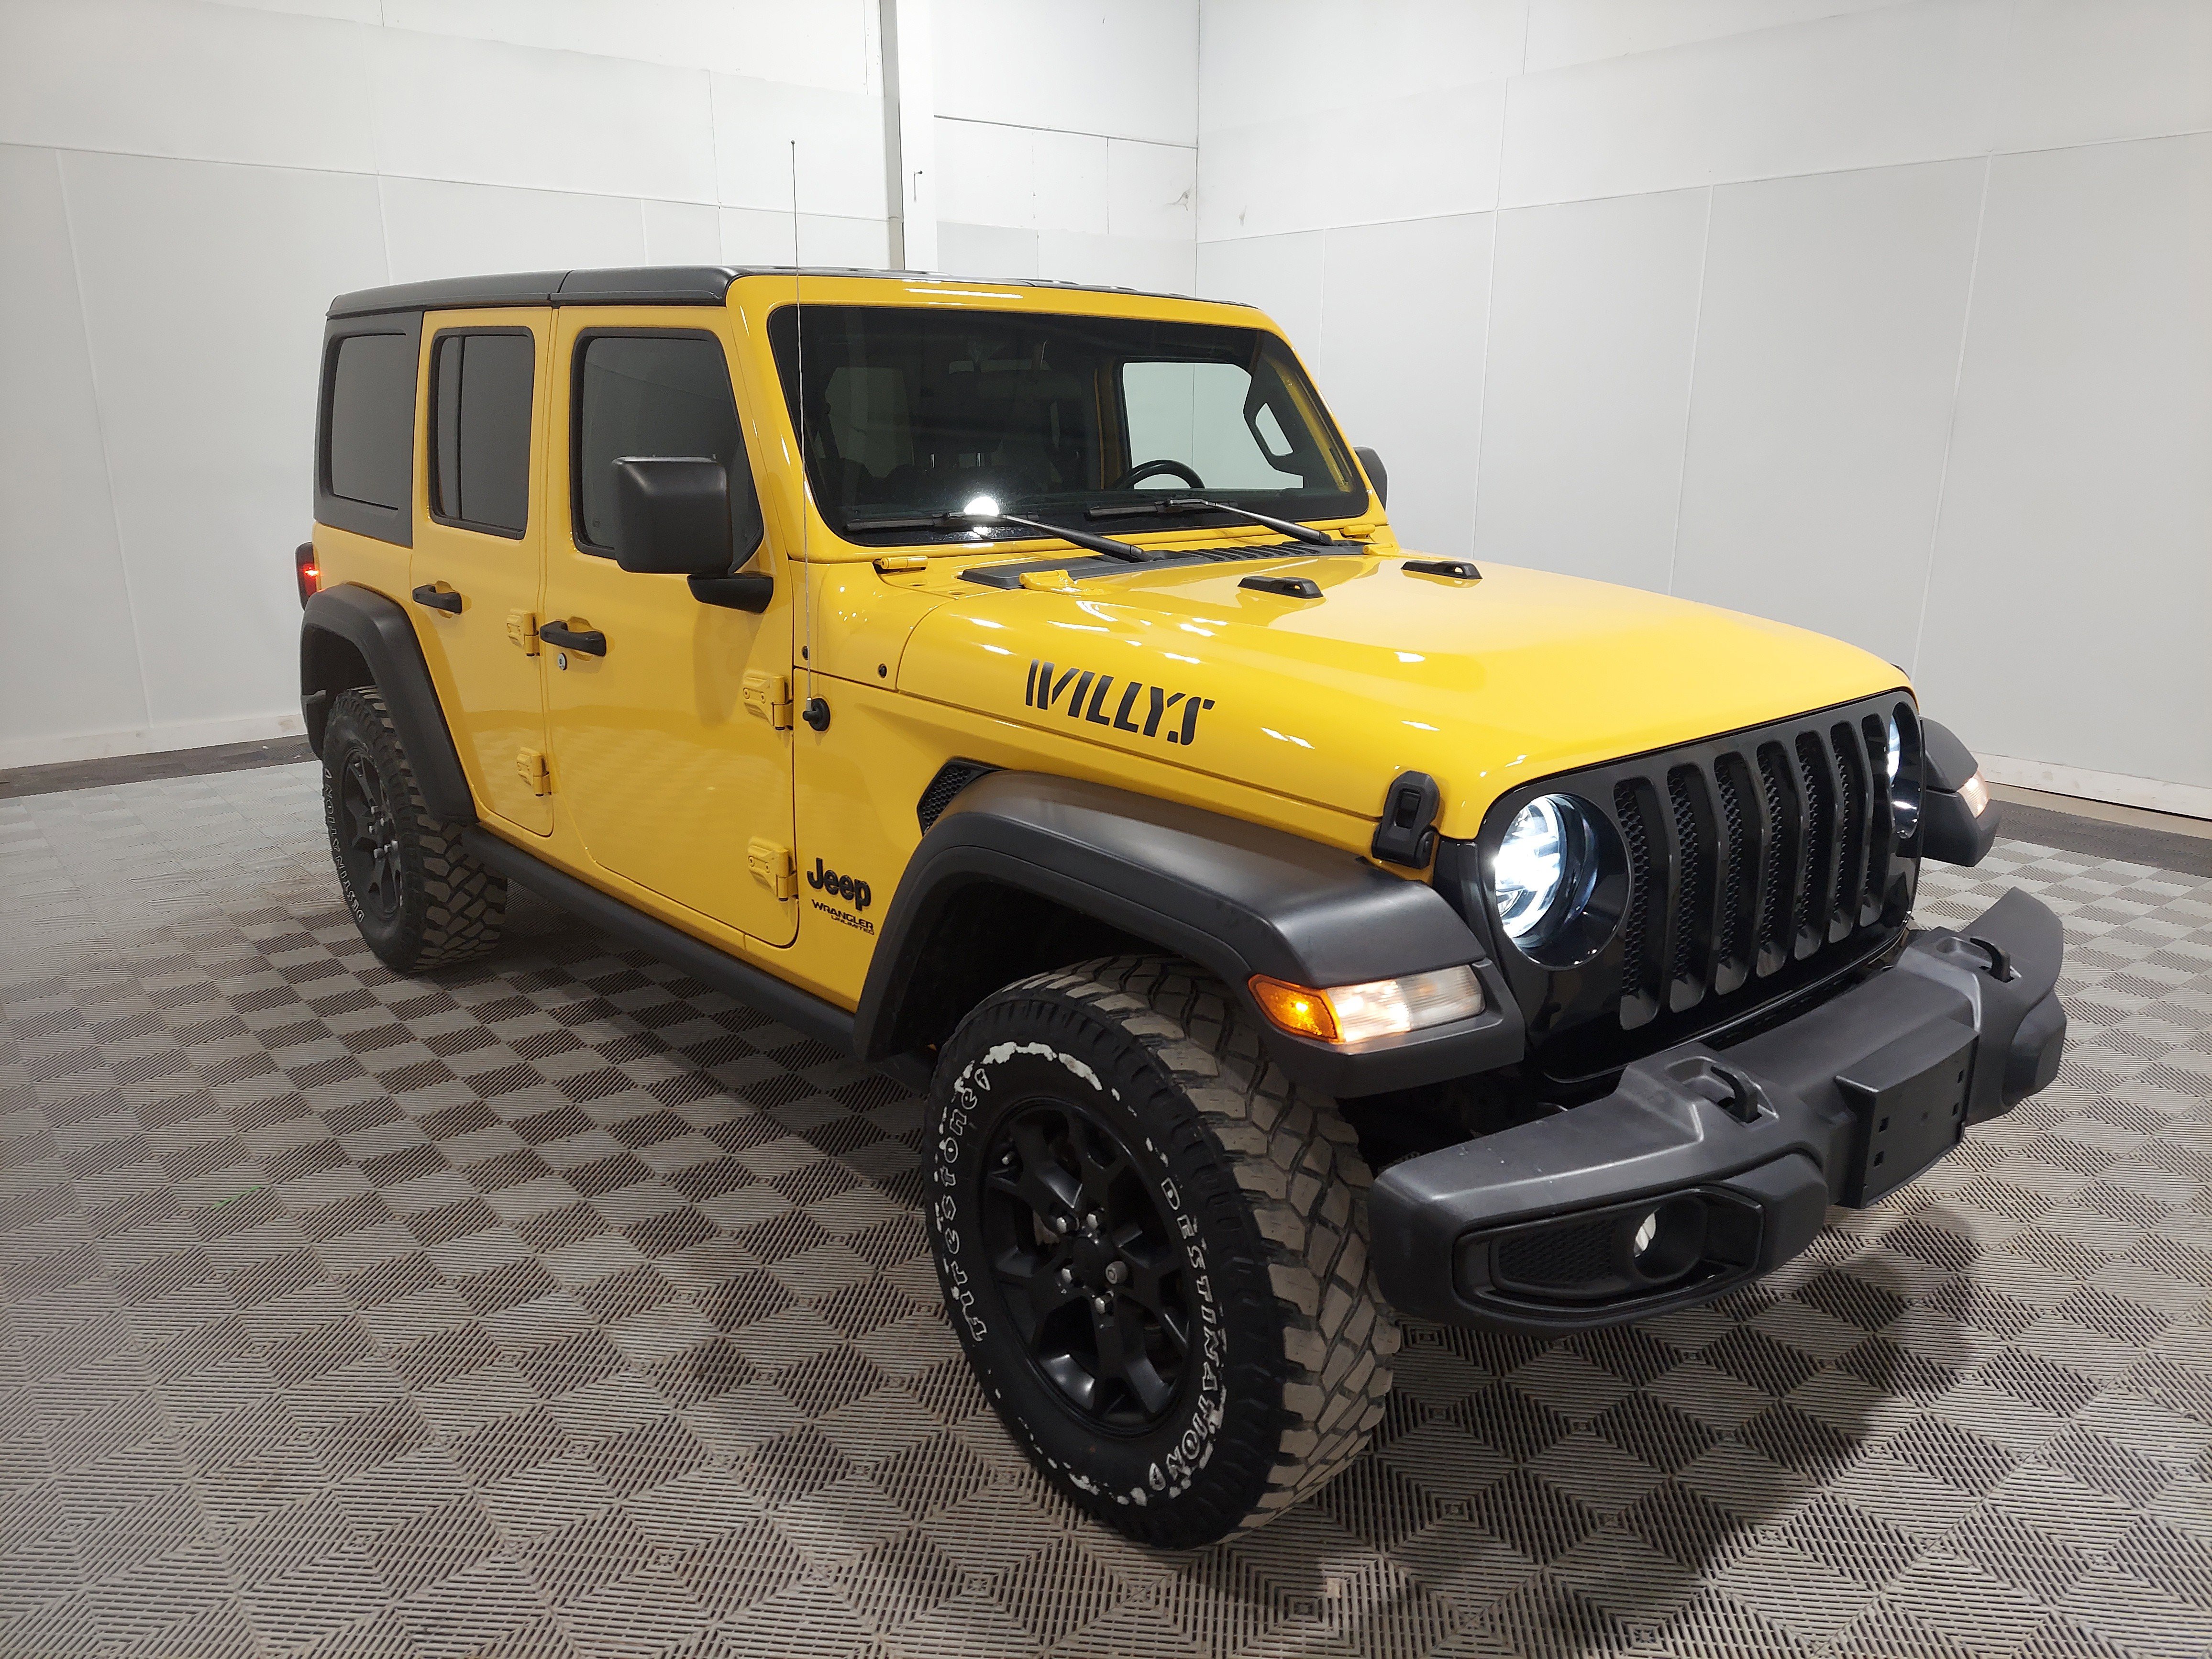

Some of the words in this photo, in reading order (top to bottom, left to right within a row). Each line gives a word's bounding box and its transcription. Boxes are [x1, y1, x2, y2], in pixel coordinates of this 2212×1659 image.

[1026, 659, 1215, 746] WILLYS
[323, 784, 365, 923] DESTINATION
[807, 857, 872, 911] Jeep
[811, 899, 874, 931] WRANGLER
[831, 915, 875, 935] UNLIMITED
[1161, 1176, 1227, 1485] DESTINATION
